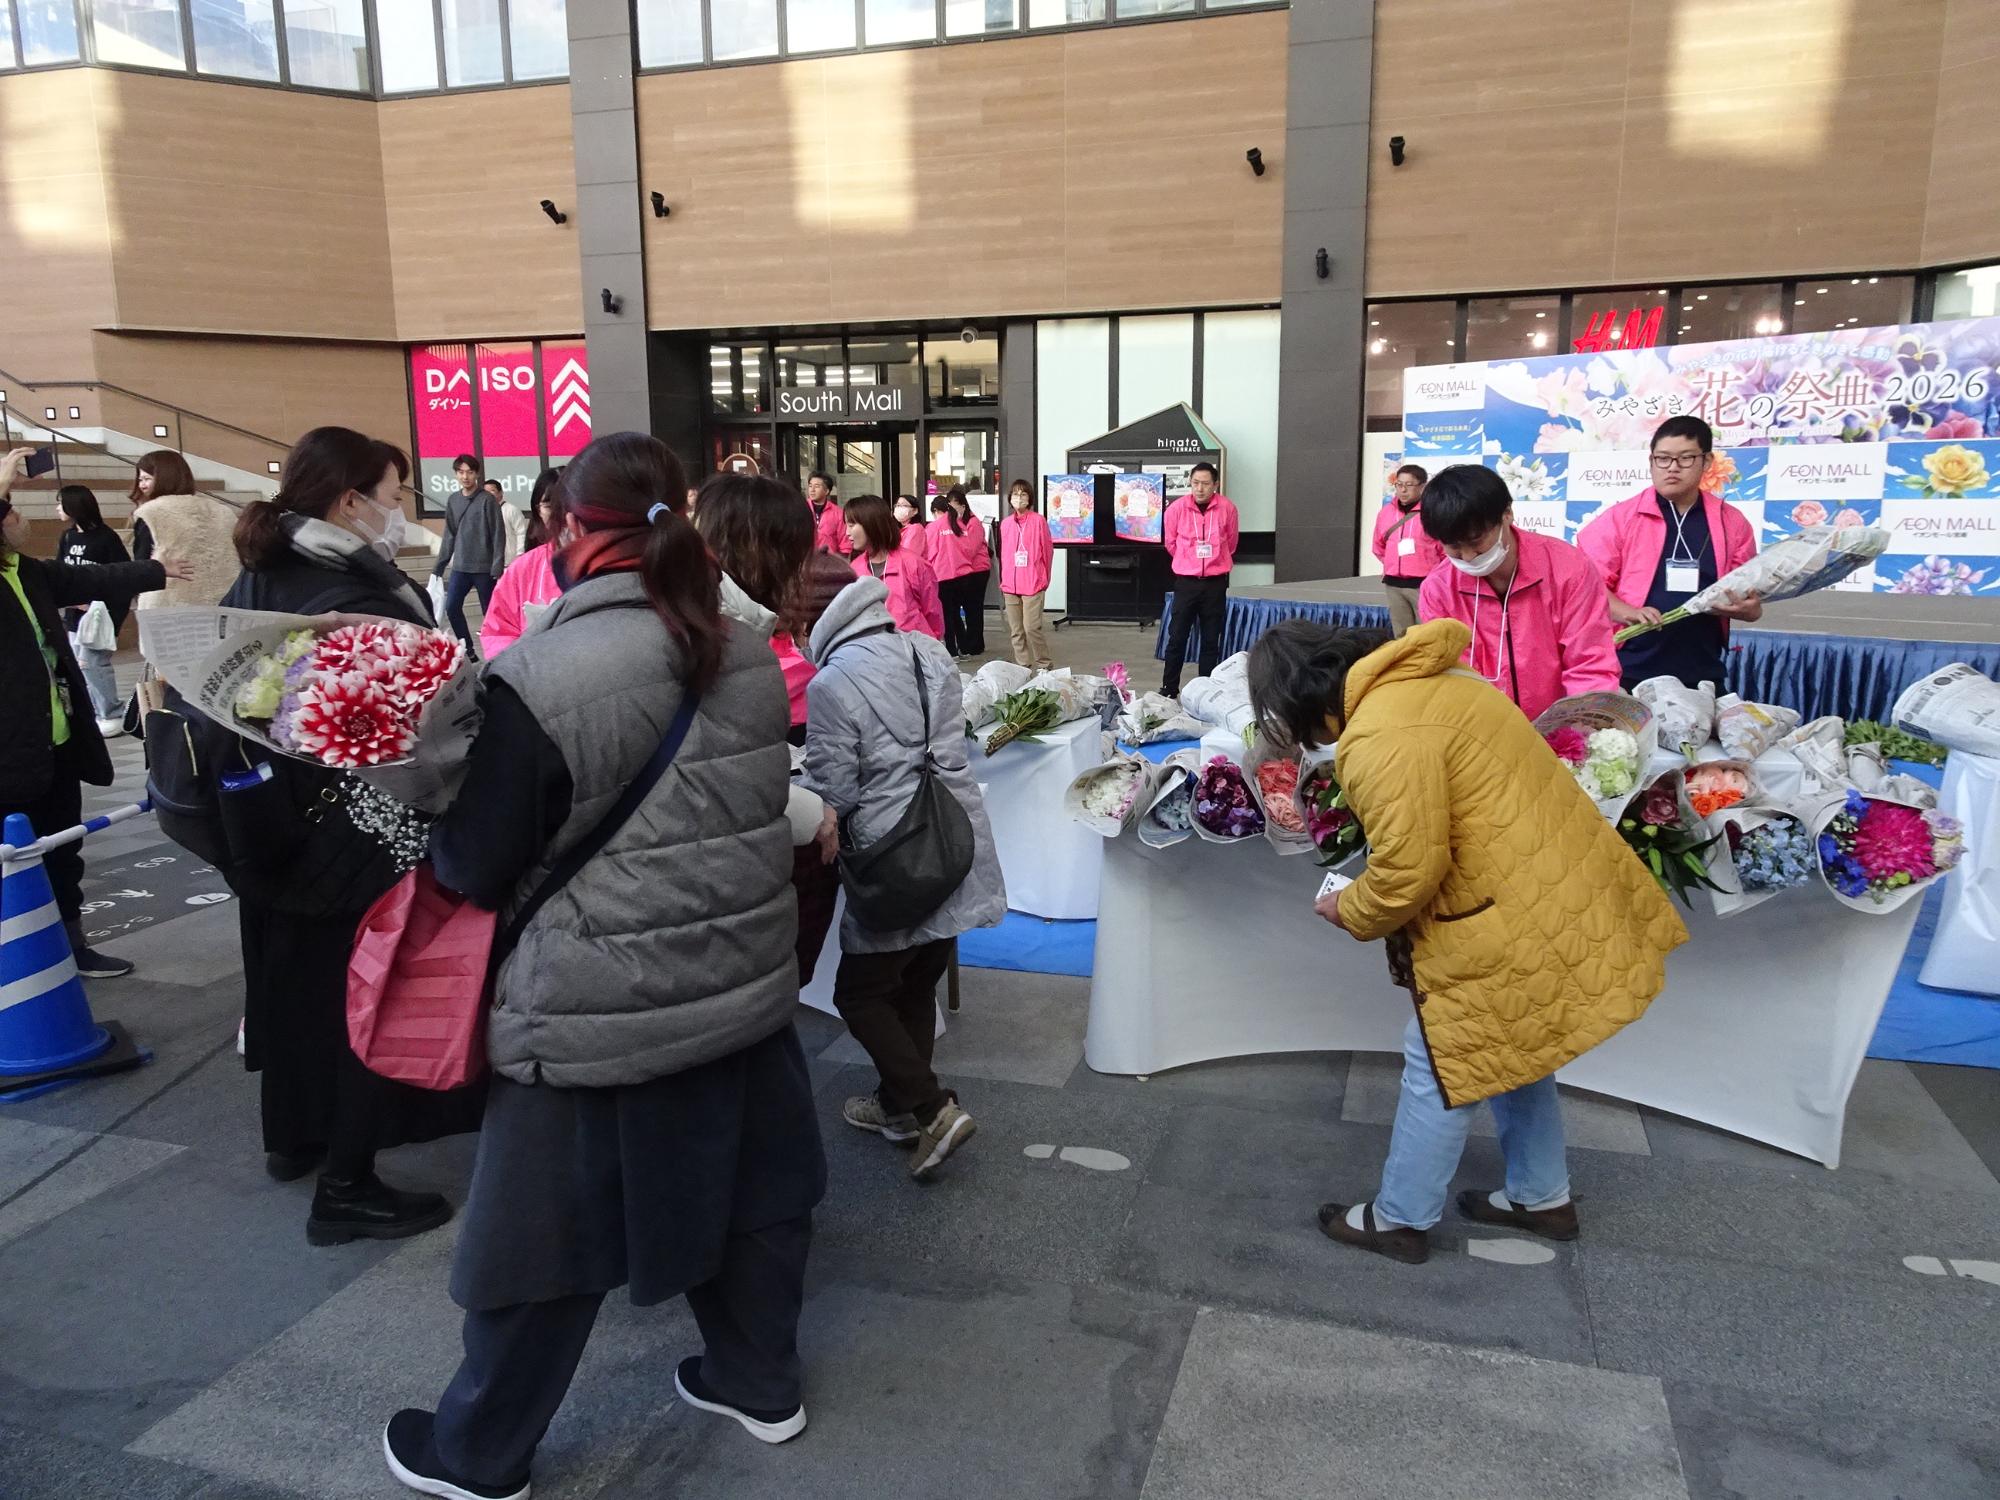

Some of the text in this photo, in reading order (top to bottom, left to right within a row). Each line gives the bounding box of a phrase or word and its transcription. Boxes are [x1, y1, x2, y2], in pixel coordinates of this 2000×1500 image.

[426, 366, 535, 393] DAISO
[1886, 369, 1986, 402] 2026
[1446, 381, 1477, 392] MALL
[429, 397, 471, 411] ダイソー
[780, 389, 902, 413] South Mall
[1157, 437, 1199, 448] hinata
[1615, 469, 1653, 480] MALL
[1827, 463, 1873, 476] MALL
[1522, 516, 1556, 528] MALL
[1947, 517, 1997, 531] MALL
